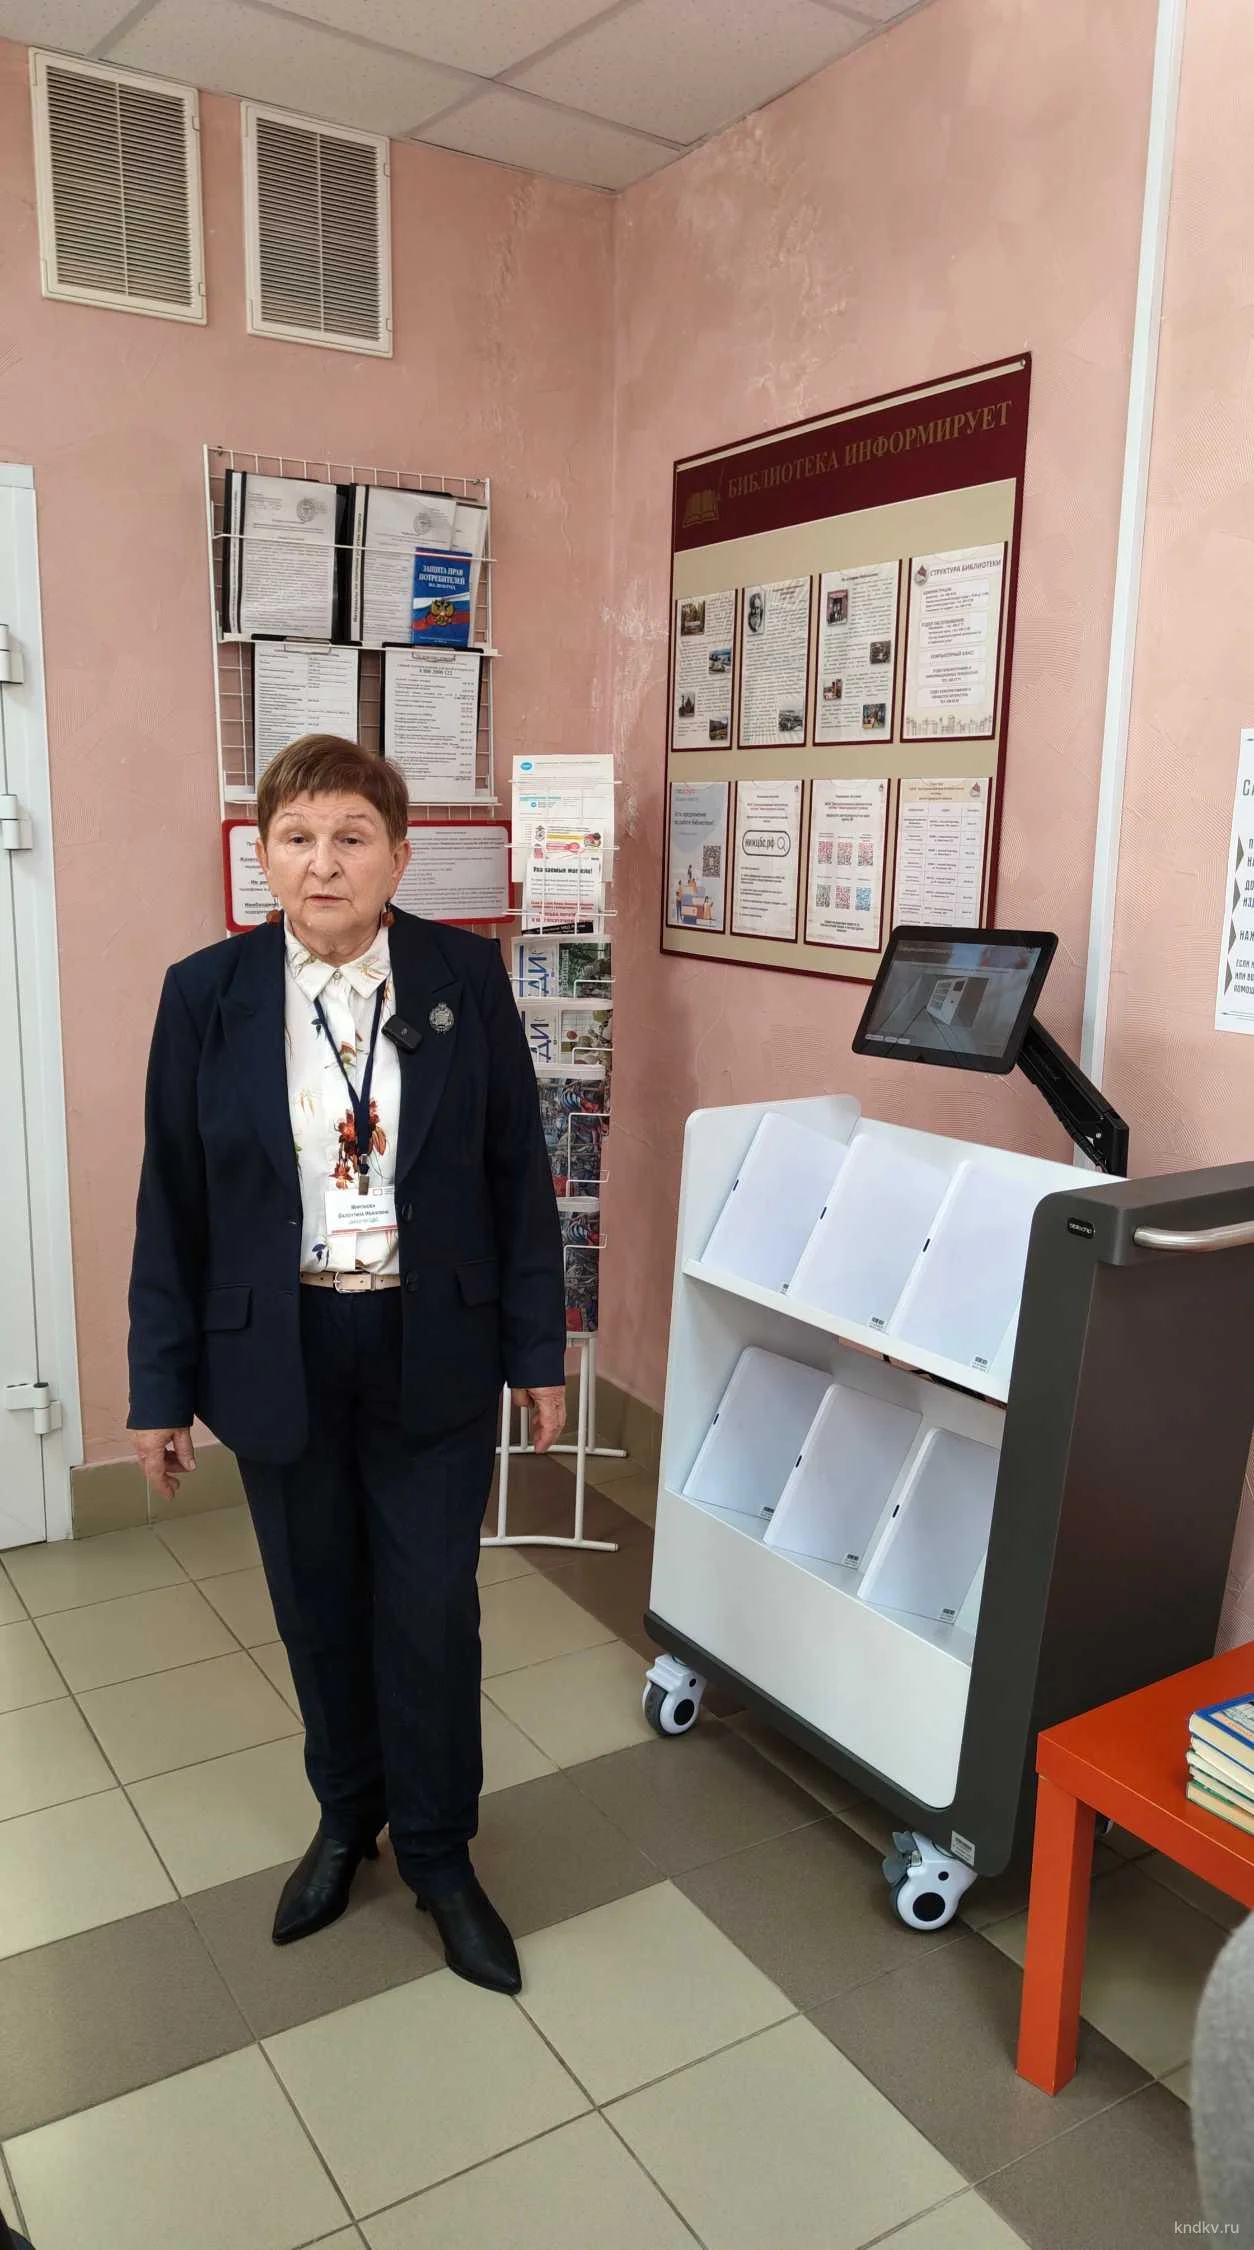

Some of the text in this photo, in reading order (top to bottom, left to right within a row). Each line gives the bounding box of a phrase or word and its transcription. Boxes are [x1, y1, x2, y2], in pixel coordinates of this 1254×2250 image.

[727, 400, 1012, 501] БИБЛИОТЕКА ИНФОРМИРУЕТ
[930, 559, 1001, 577] СТРУКТУРА БИБЛИОТЕКИ
